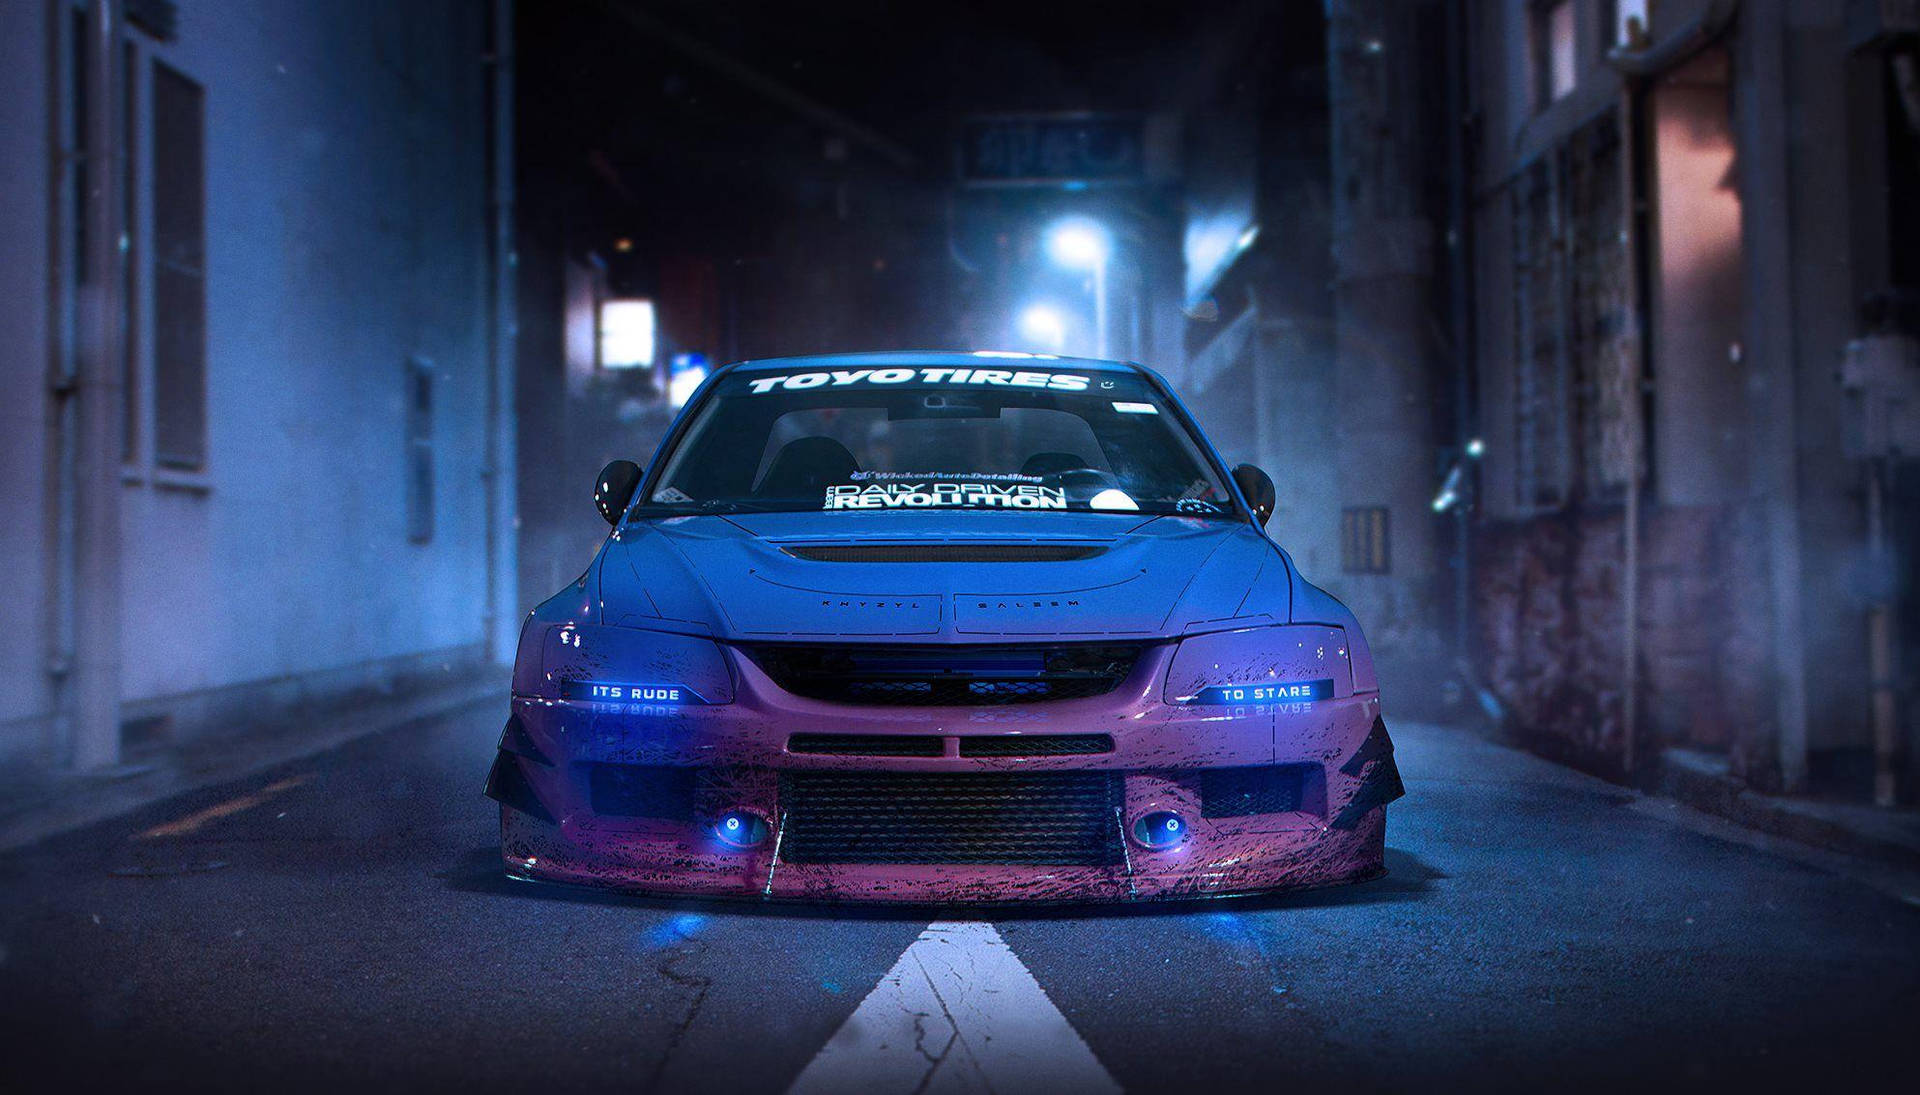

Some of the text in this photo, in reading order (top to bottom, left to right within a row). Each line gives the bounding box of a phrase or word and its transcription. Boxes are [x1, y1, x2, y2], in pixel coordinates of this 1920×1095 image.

[750, 368, 1090, 394] TOYO TIRES
[835, 483, 1065, 497] DAILY DRIVEN
[833, 493, 1068, 509] REVOLUTION
[593, 686, 679, 700] ITS RUDE
[1222, 685, 1311, 701] TO STARE
